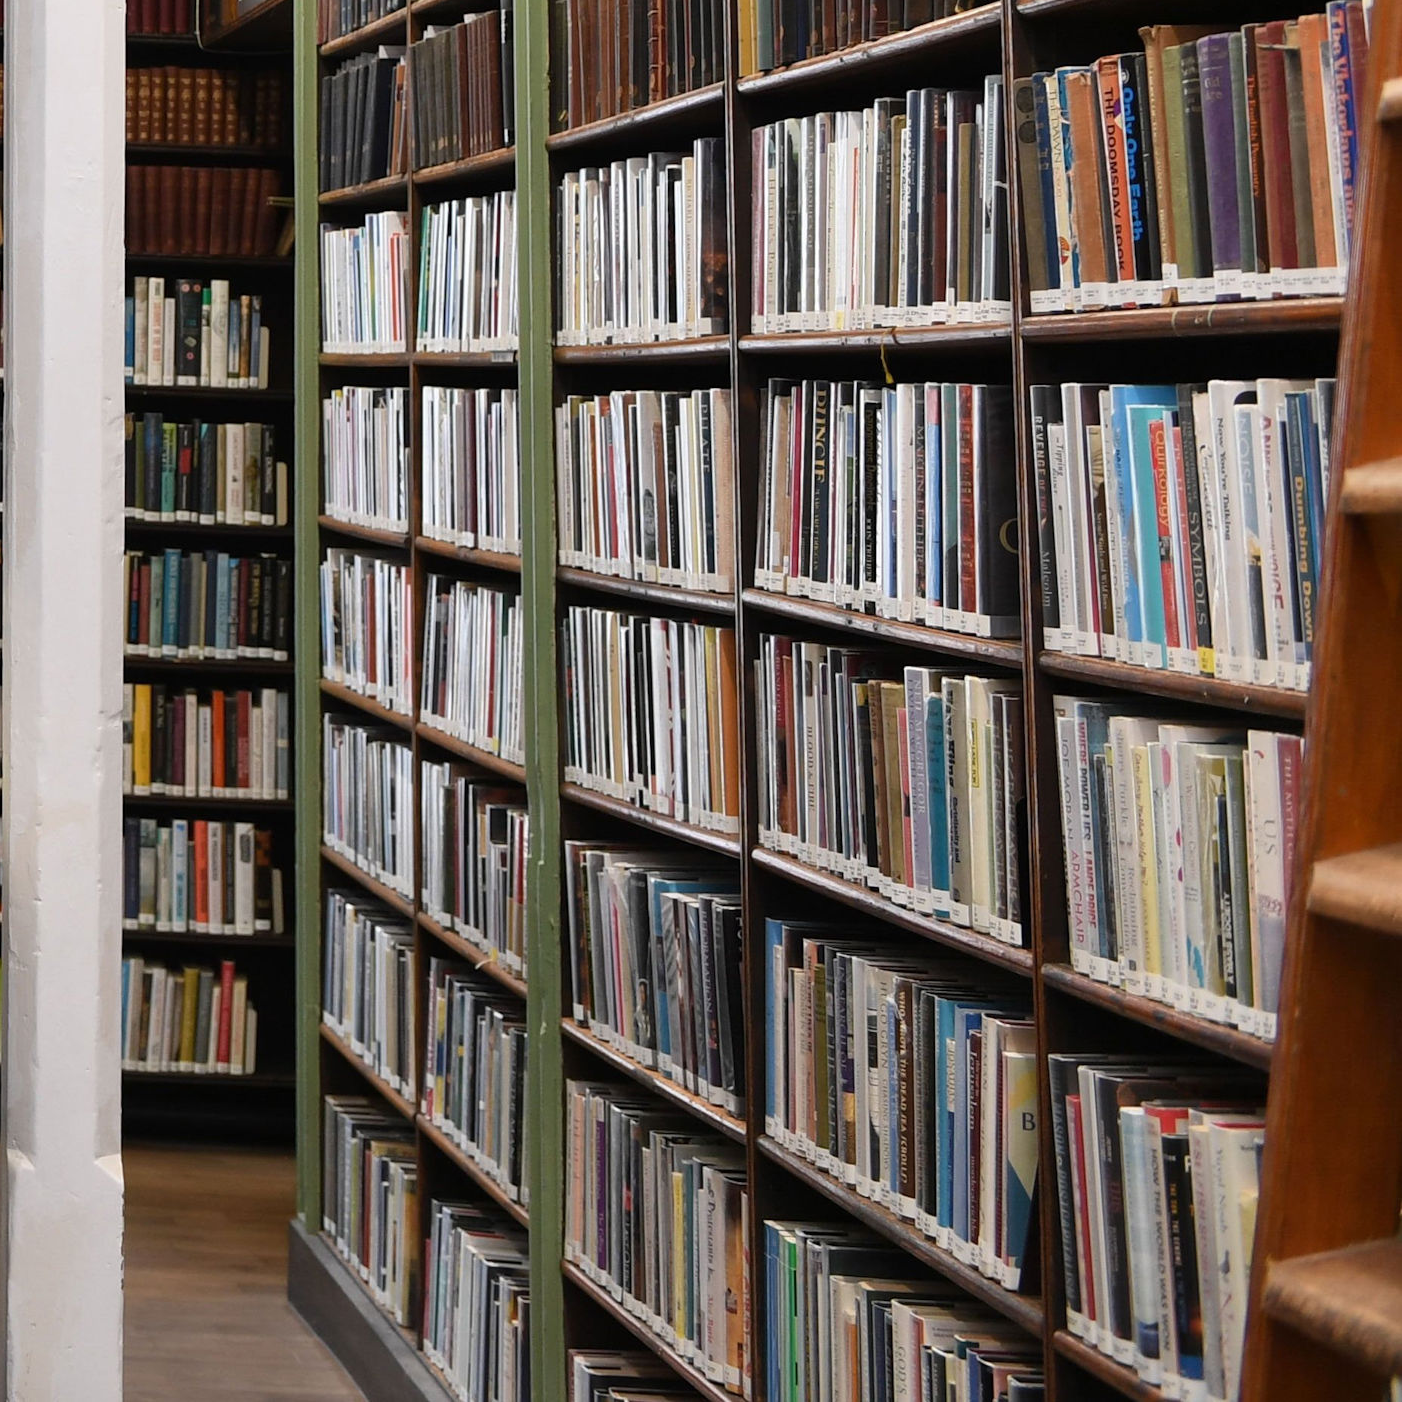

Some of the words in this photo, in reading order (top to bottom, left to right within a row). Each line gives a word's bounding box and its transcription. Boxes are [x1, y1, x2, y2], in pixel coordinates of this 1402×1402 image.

[1331, 8, 1346, 55] The
[1102, 87, 1114, 121] THE
[1122, 87, 1135, 136] Only
[1333, 56, 1354, 182] Victorians
[1105, 125, 1122, 219] DOOMSDAY
[1127, 139, 1139, 183] One
[1131, 187, 1144, 242] Earth
[1114, 223, 1127, 272] BOOK
[699, 402, 712, 474] PILATE
[1216, 416, 1226, 449] Now
[1219, 453, 1229, 492] You're
[1238, 415, 1254, 498] NOISE
[1294, 474, 1310, 574] Dumbing
[1042, 549, 1052, 608] Malcolm
[1188, 508, 1208, 627] SYMBOLS
[1301, 579, 1315, 644] Down
[806, 725, 814, 764] BLOOD
[1061, 738, 1070, 767] JOE
[1064, 774, 1074, 841] MORAN
[1070, 849, 1085, 945] ARMCHAIR
[900, 1057, 908, 1075] THE
[900, 1077, 909, 1112] DEAD
[900, 1113, 909, 1132] SEA
[1148, 1148, 1159, 1186] HOW
[1153, 1189, 1162, 1215] THE
[1159, 1277, 1169, 1312] WAS
[1162, 1319, 1172, 1352] WON
